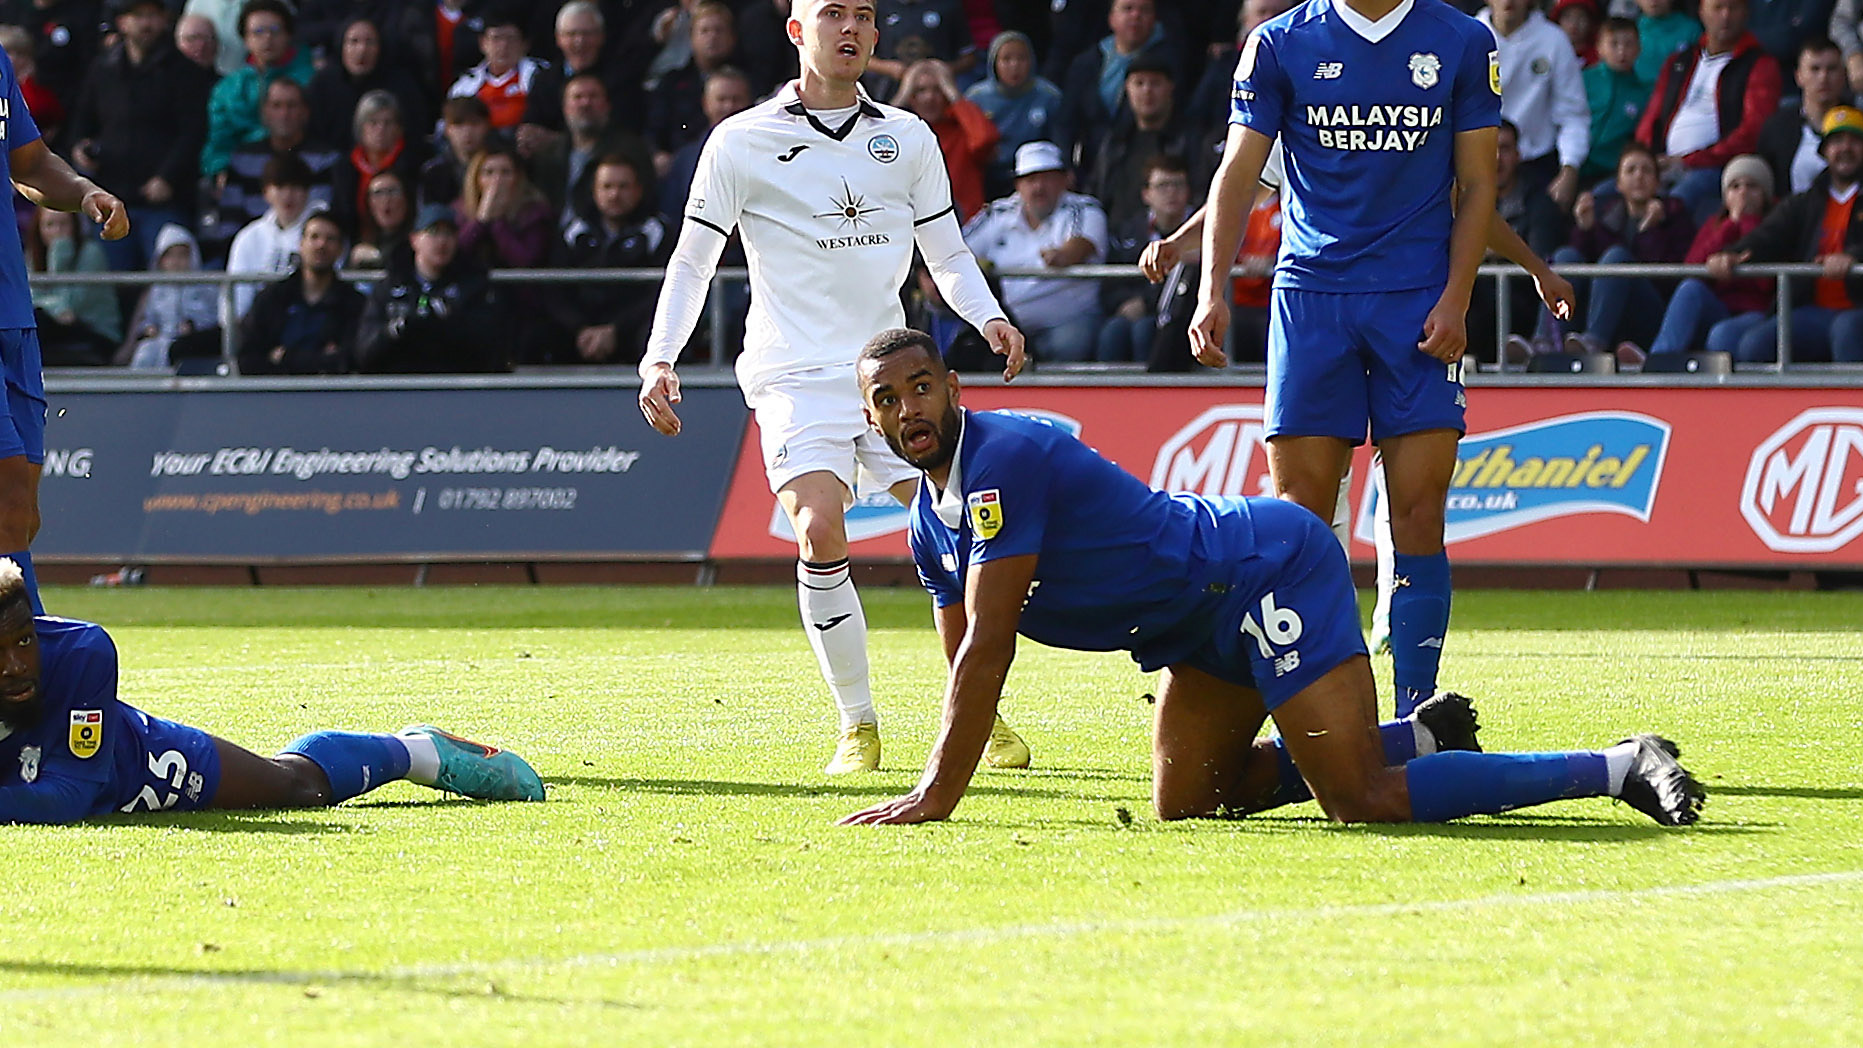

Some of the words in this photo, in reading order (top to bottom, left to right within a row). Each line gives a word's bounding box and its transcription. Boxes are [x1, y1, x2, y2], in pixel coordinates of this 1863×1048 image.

[1306, 104, 1443, 128] MALAYSIA
[1318, 128, 1429, 152] BERJAYA
[815, 232, 890, 250] WESTACRES
[43, 449, 94, 477] NG
[150, 450, 211, 477] Your
[210, 447, 273, 476] EC&I
[270, 446, 416, 480] Engineering
[415, 445, 532, 473] Solutions
[530, 445, 641, 473] Provider
[1450, 443, 1651, 489] thaniel
[1240, 591, 1303, 660] 16
[120, 749, 188, 813] 25
